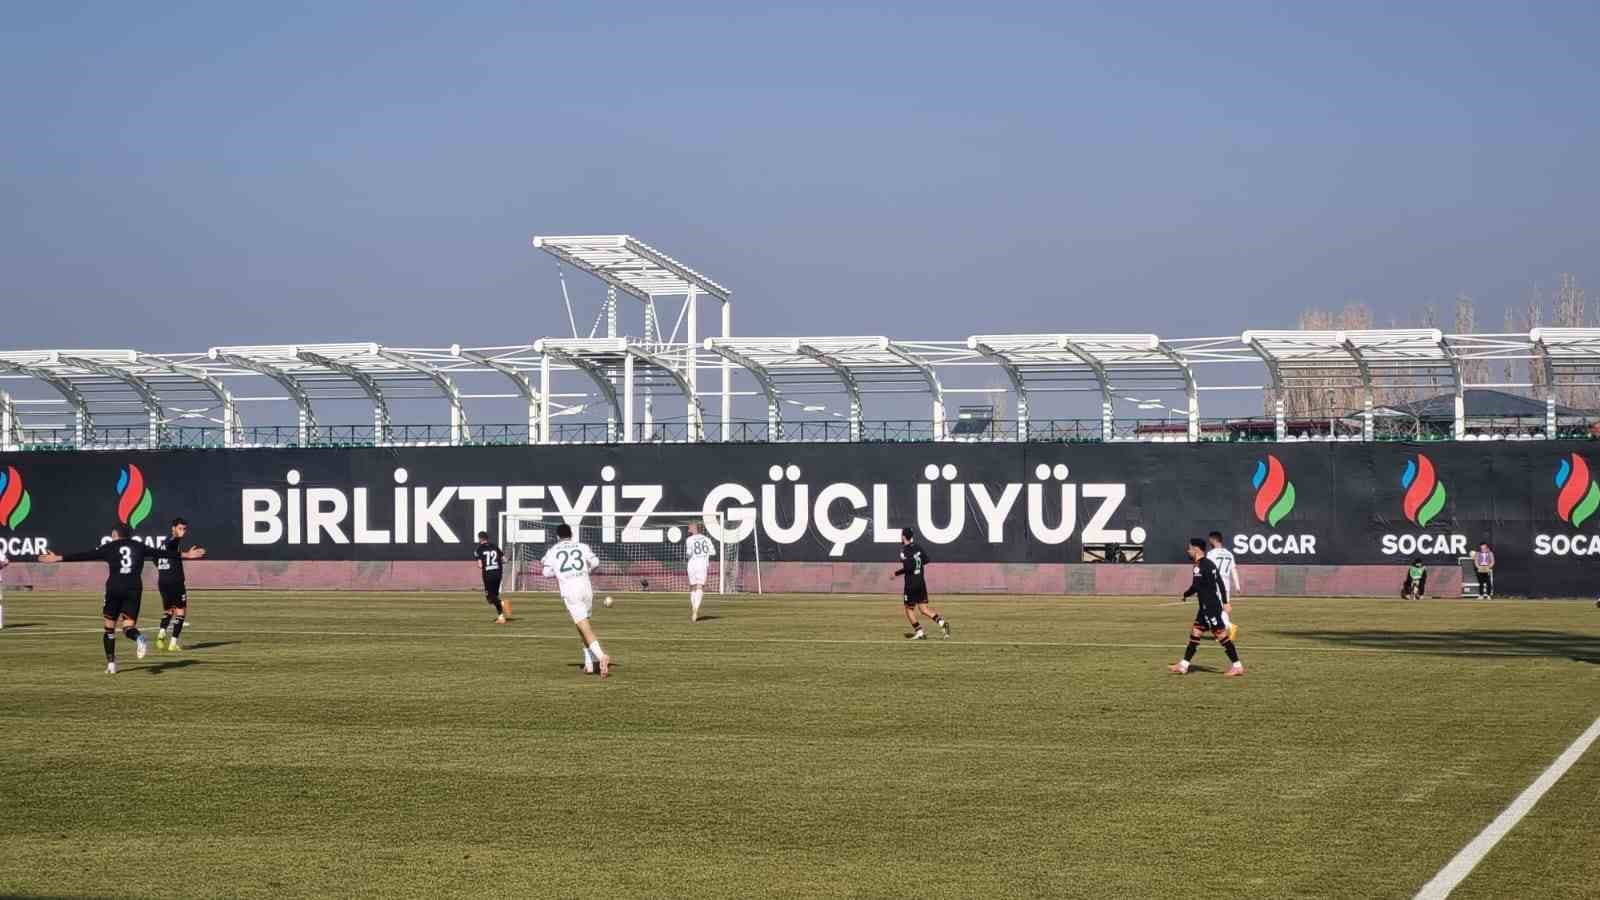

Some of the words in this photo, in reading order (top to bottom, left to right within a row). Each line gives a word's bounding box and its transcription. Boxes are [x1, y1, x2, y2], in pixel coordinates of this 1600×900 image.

[241, 466, 682, 545] BİRLİKTEYİZ.
[701, 463, 1147, 557] GÜÇLÜYÜZ.
[693, 540, 709, 555] 86
[1232, 533, 1317, 556] SOCAR
[1381, 533, 1468, 556] SOCAR
[1534, 533, 1600, 556] SOCA
[119, 545, 132, 568] 3
[555, 549, 585, 573] 23
[1215, 556, 1233, 577] 77
